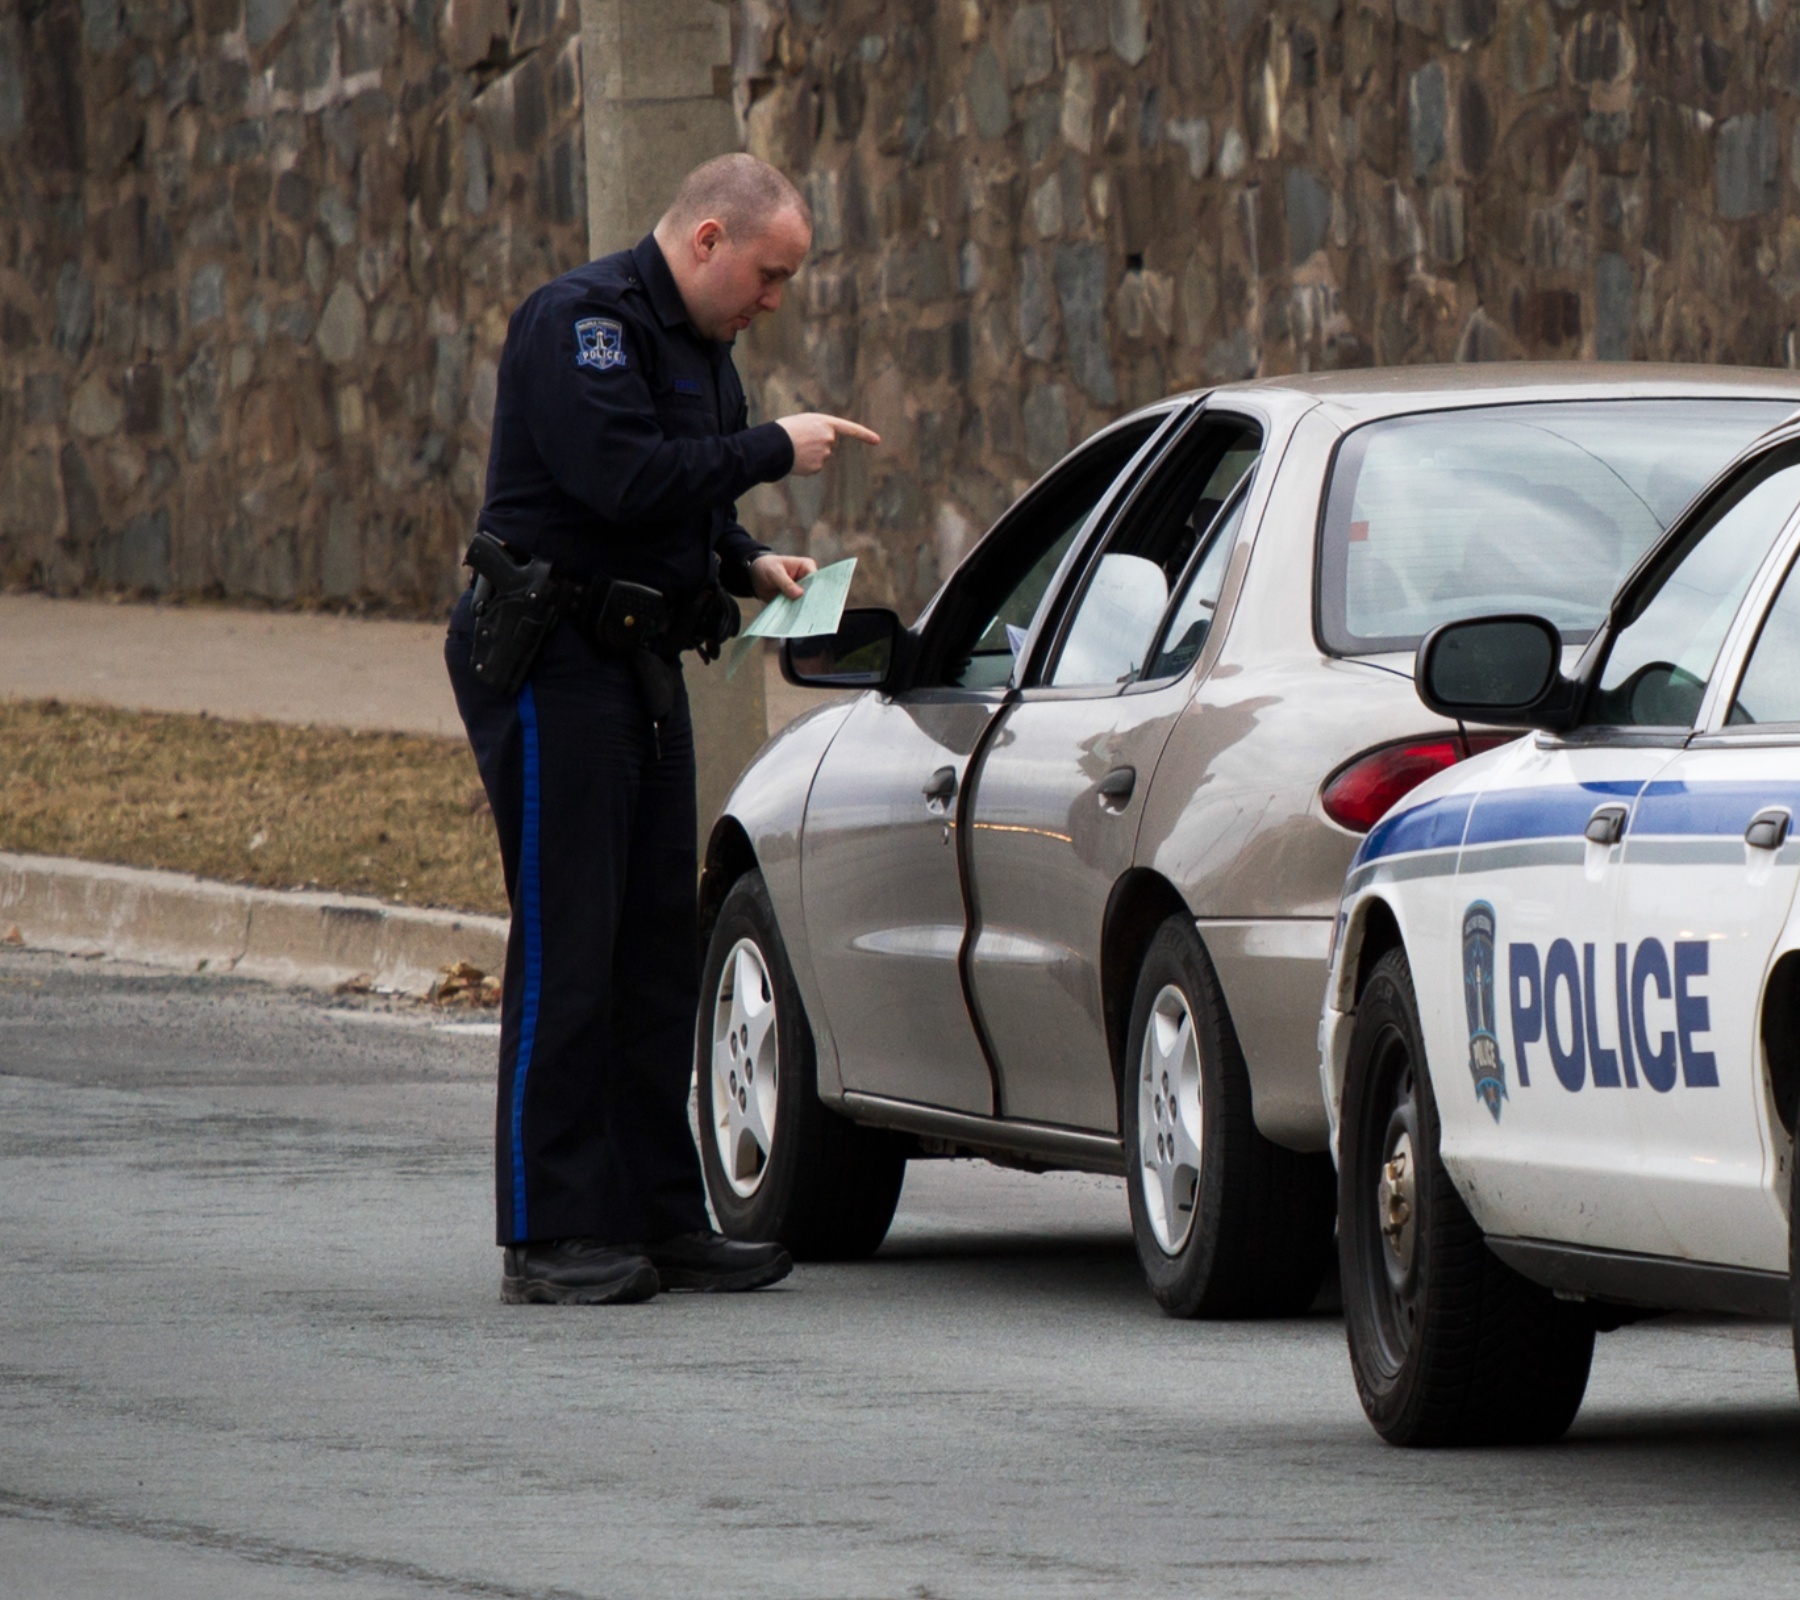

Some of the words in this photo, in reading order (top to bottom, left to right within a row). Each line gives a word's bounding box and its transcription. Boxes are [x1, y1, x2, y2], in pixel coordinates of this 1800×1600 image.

[582, 350, 620, 361] POLICE
[1508, 936, 1720, 1093] POLICE
[1472, 1038, 1498, 1071] POLICE
